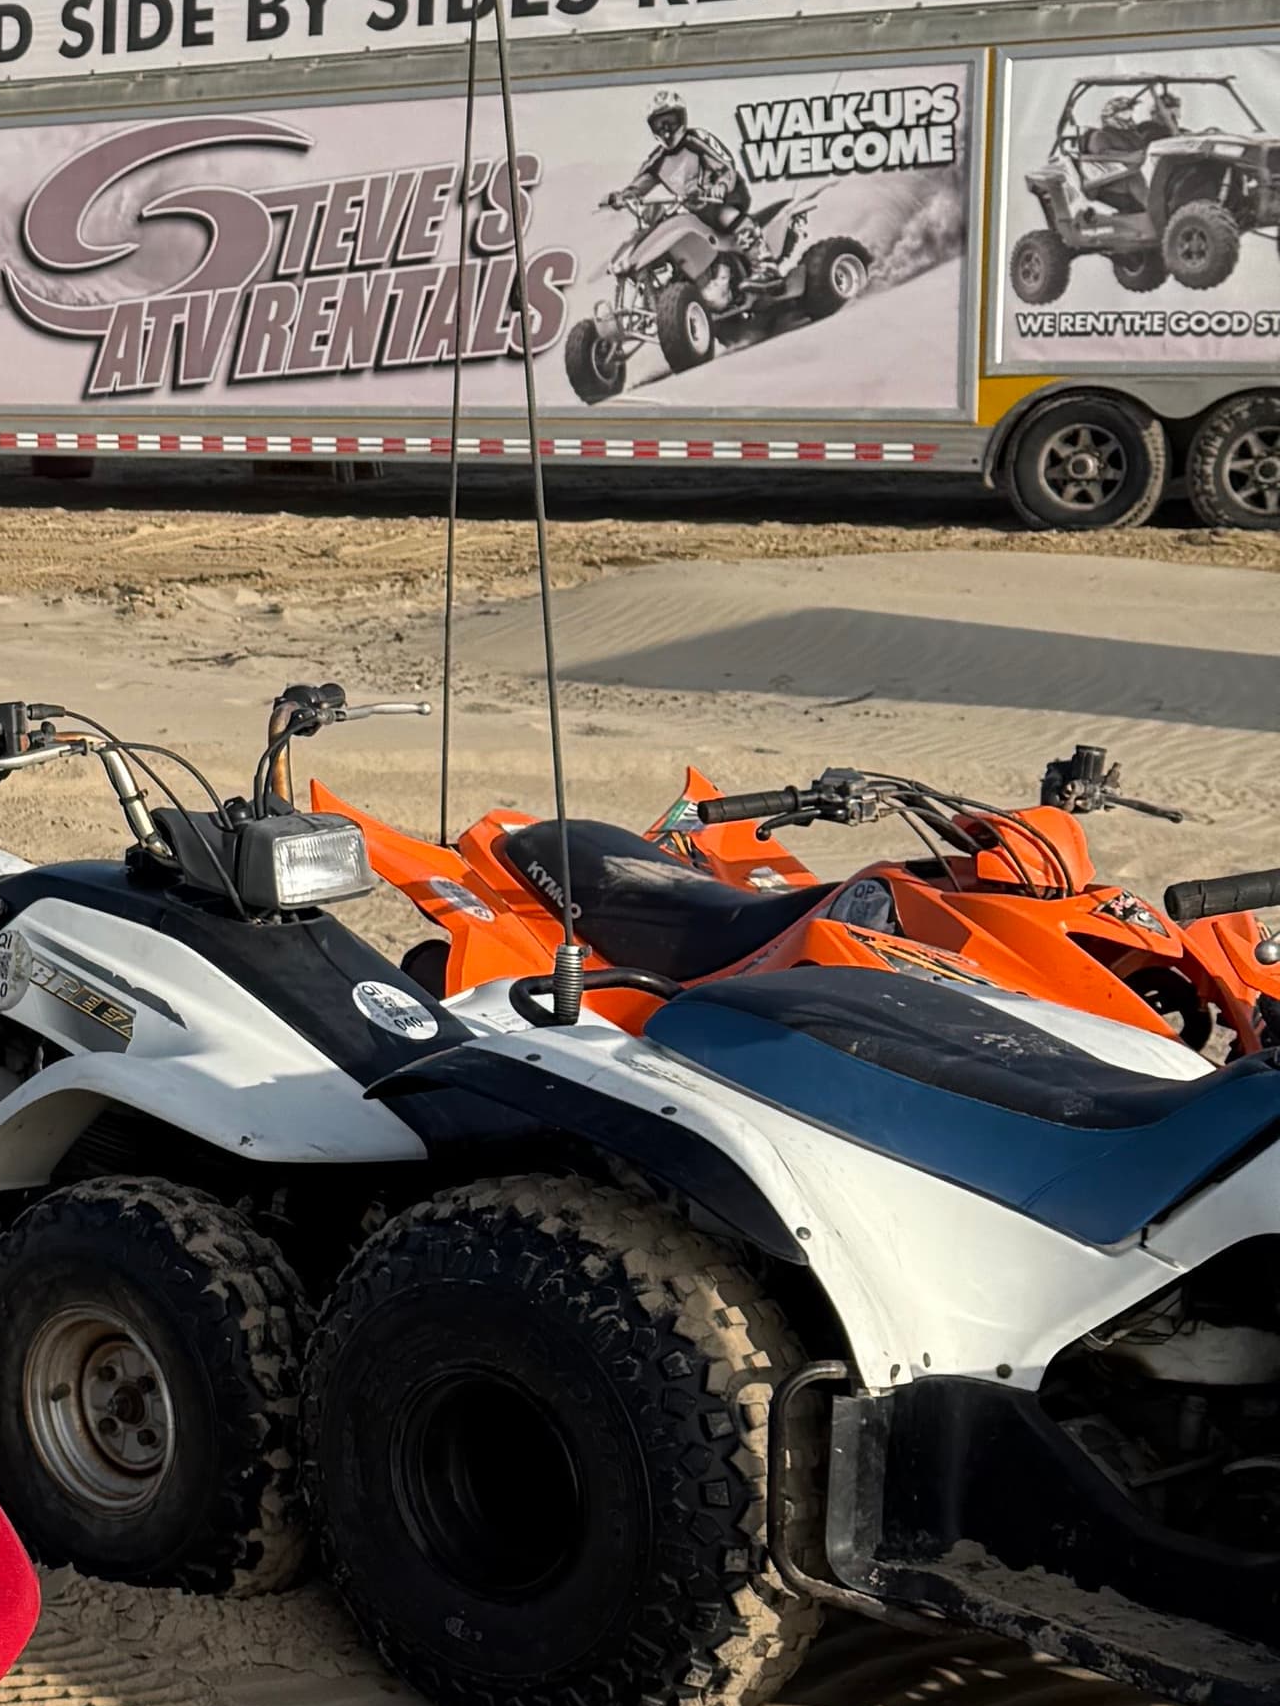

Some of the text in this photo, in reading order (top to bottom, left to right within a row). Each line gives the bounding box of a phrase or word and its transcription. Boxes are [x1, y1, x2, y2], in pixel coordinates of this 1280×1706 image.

[736, 83, 960, 141] WALK-UPS
[742, 124, 956, 181] WELCOME
[87, 248, 577, 395] ATV RENTALS
[1016, 312, 1056, 337] WE
[1057, 312, 1120, 336] RENT
[1120, 311, 1167, 336] THE
[1168, 310, 1251, 336] GOOD
[393, 1016, 424, 1031] 040
